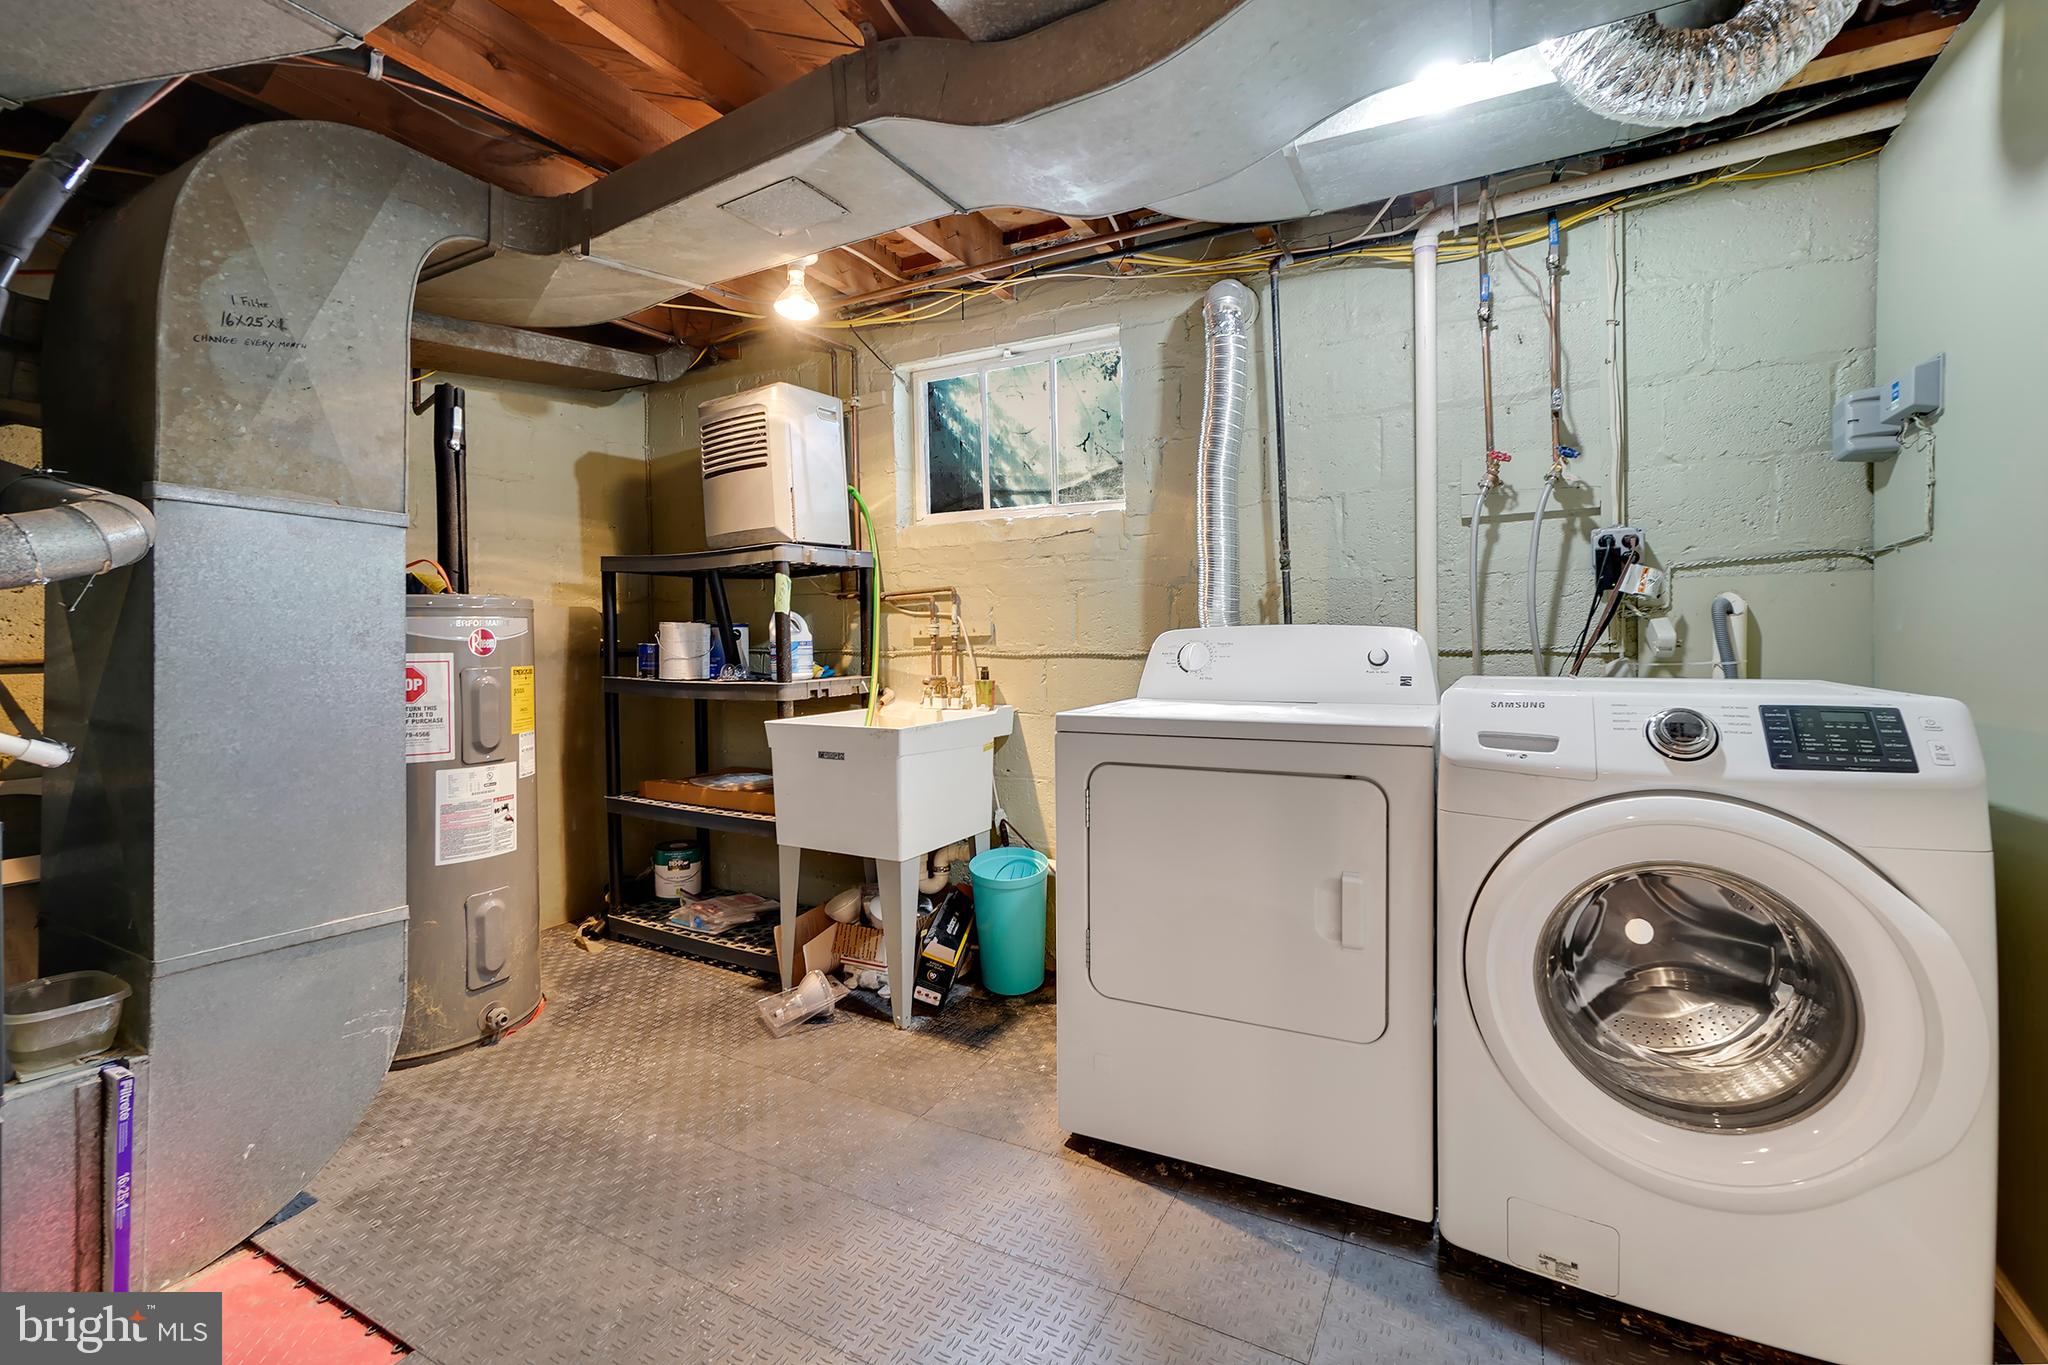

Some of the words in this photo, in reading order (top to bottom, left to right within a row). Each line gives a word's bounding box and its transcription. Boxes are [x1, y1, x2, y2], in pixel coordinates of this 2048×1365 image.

[1687, 149, 1729, 165] NOT
[1629, 162, 1671, 179] FOR
[1511, 176, 1615, 207] PRESSURE
[192, 333, 238, 345] CHANGE
[243, 338, 275, 352] EVERY
[278, 341, 307, 349] MONTH
[1490, 701, 1546, 709] SAMSUNG
[411, 717, 444, 725] PURCHASE
[119, 1079, 133, 1121] Filtrete
